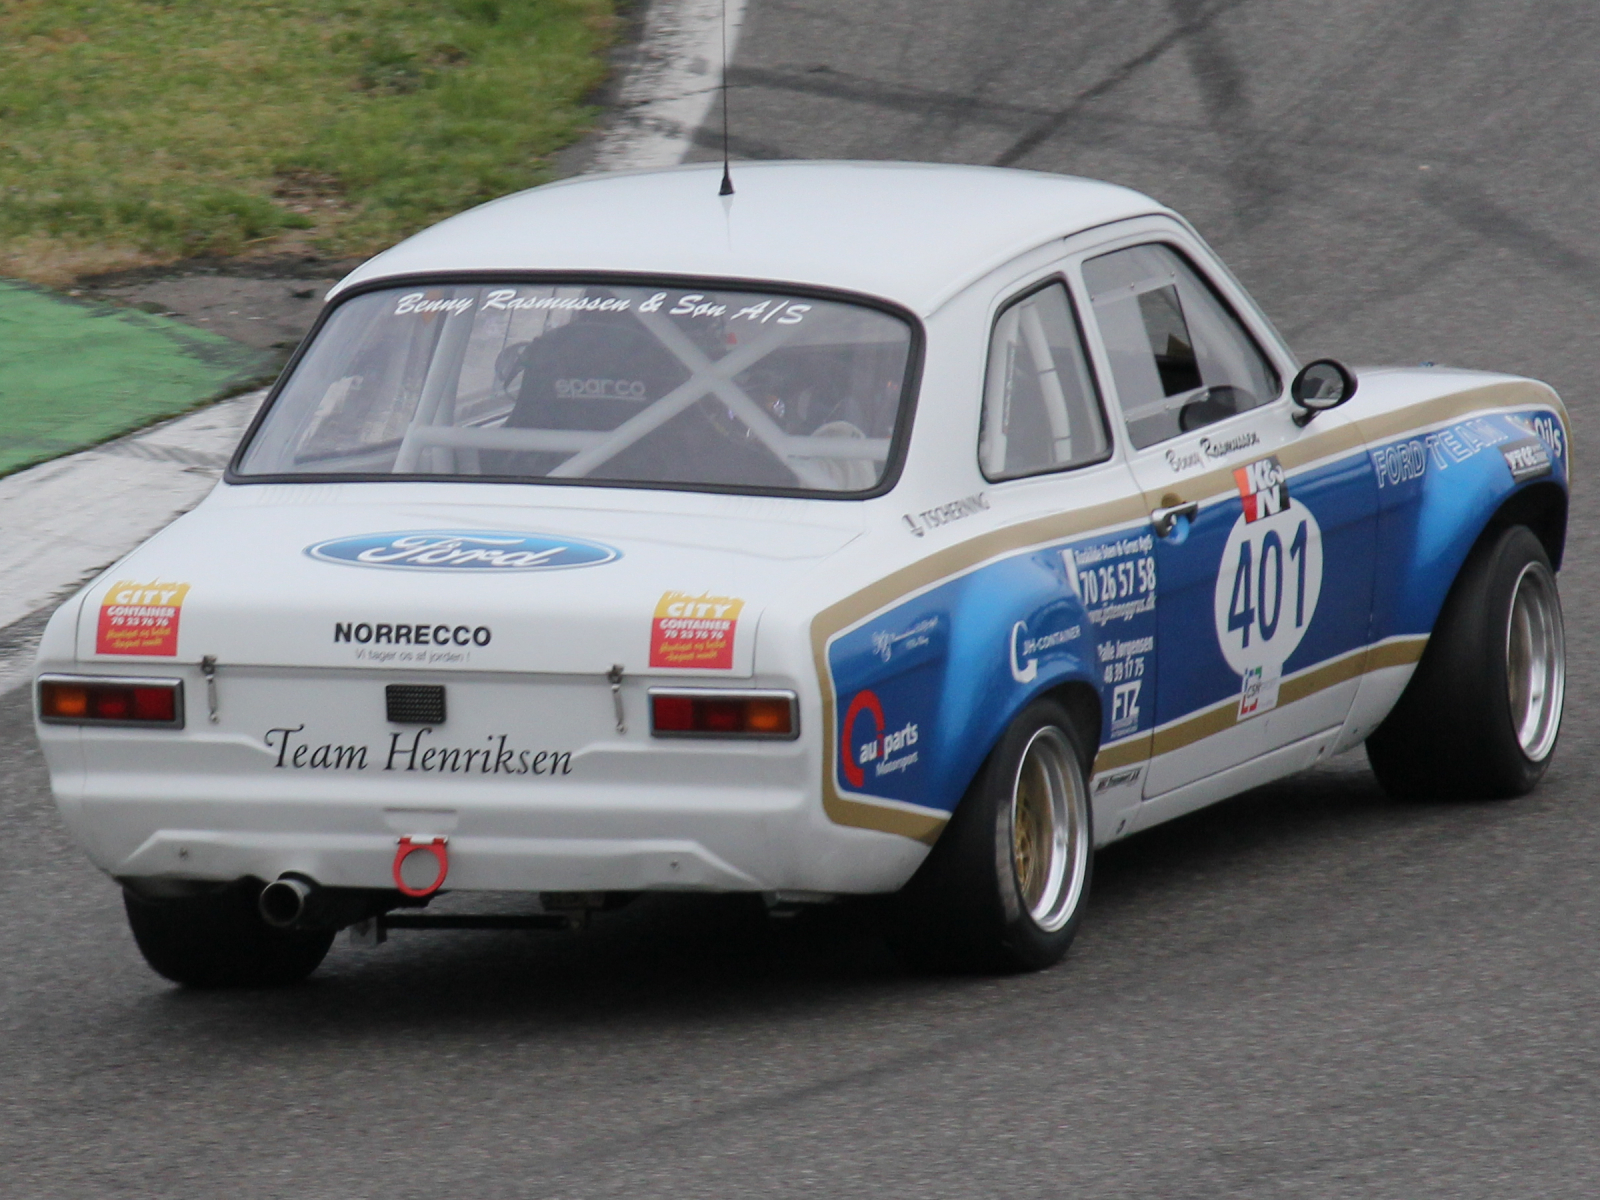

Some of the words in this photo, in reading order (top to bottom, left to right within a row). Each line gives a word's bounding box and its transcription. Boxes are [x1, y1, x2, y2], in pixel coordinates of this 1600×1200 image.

[394, 292, 473, 316] Benny
[481, 289, 630, 312] Rasmussen
[639, 292, 667, 311] &
[730, 300, 812, 325] A/S
[555, 377, 646, 397] sparco
[1372, 440, 1426, 489] FORD
[919, 492, 990, 529] TSCHERNING
[357, 535, 568, 566] Ford
[1079, 569, 1099, 606] 70
[1098, 565, 1117, 601] 26
[1118, 561, 1134, 598] 57
[1138, 556, 1156, 593] 58
[1228, 519, 1308, 649] 401
[115, 590, 178, 605] CITY
[667, 601, 733, 618] CITY
[107, 606, 175, 617] CONTAINER
[111, 616, 125, 625] 70
[659, 618, 731, 630] CONTAINER
[334, 622, 491, 646] NORRECCO
[664, 629, 678, 639] 70
[1112, 679, 1142, 721] FTZ
[264, 724, 368, 770] Team
[383, 727, 573, 775] Henriksen
